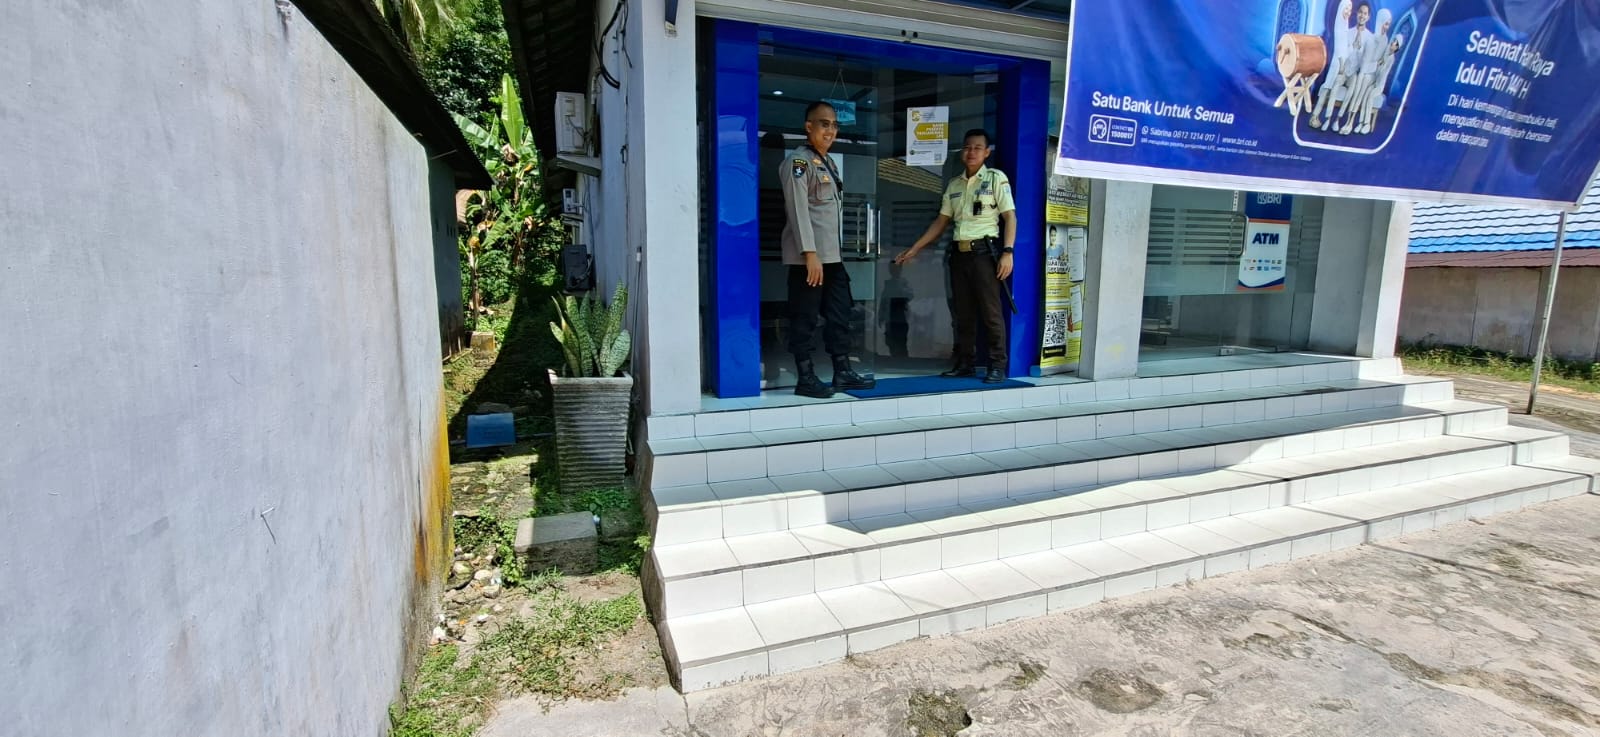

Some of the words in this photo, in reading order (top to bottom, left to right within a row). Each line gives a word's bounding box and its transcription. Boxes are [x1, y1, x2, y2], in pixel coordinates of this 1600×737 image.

[1466, 30, 1524, 63] Selamat
[1455, 61, 1487, 86] Idul
[1485, 67, 1511, 93] Fitri
[1518, 80, 1531, 99] H
[1092, 91, 1120, 109] Satu
[1122, 96, 1152, 114] Bank
[1154, 101, 1192, 119] Untuk
[1194, 106, 1234, 124] Semua
[1447, 94, 1457, 106] Di
[1458, 96, 1475, 109] hari
[1204, 133, 1216, 142] 017
[1252, 232, 1279, 245] ATM
